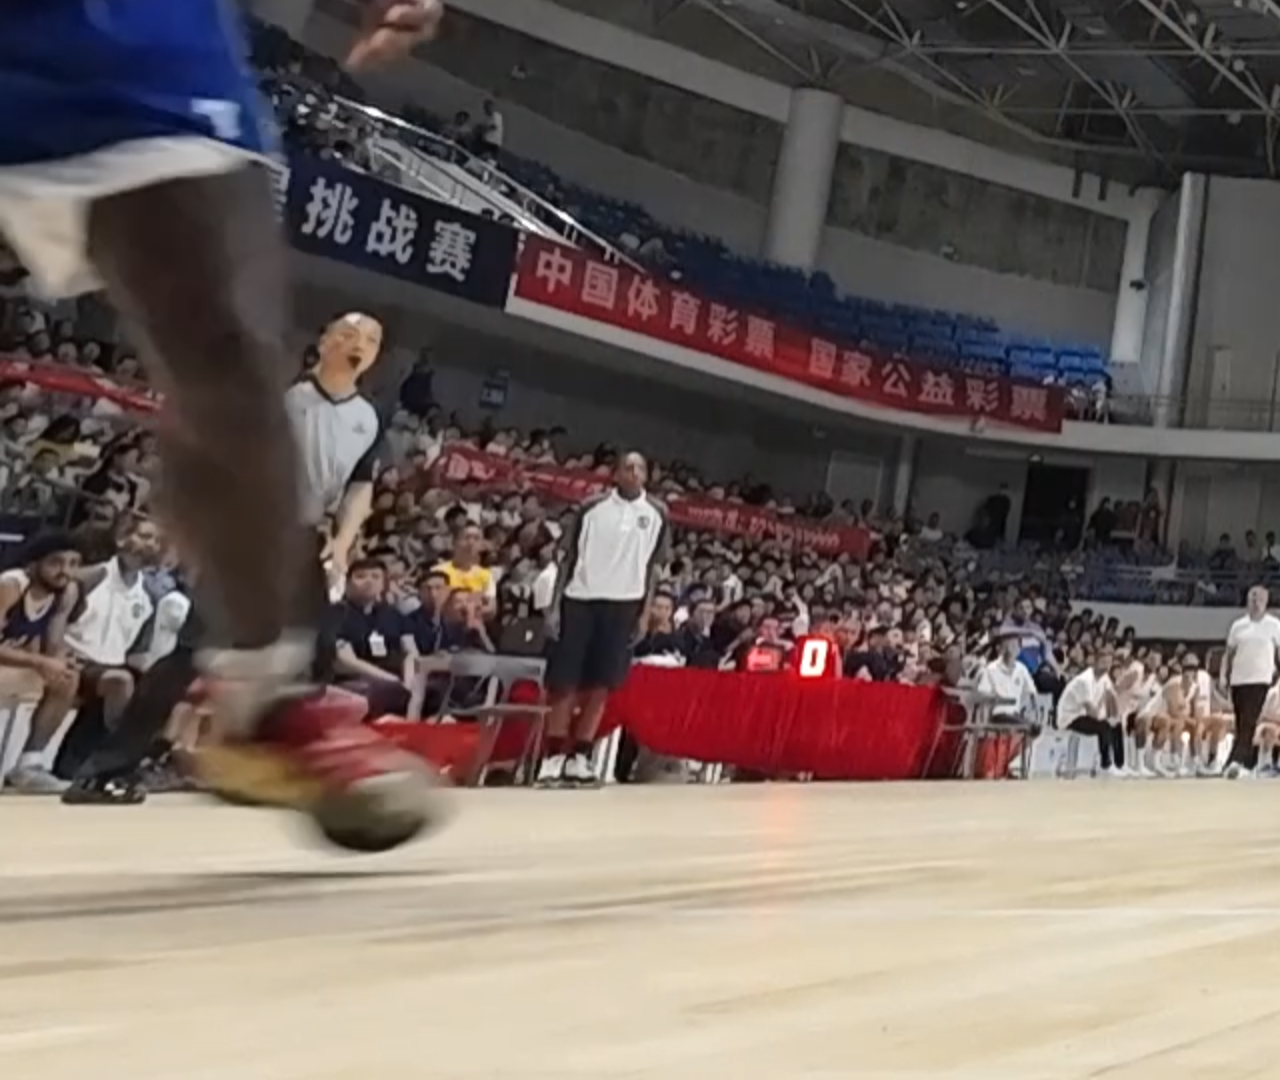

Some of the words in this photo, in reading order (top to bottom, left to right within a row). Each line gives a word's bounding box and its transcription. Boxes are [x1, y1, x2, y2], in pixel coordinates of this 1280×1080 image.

[270, 170, 477, 282] 挑战赛
[536, 247, 777, 360] 中国体育彩票
[808, 337, 1049, 422] 国家公益彩票
[800, 639, 829, 677] 0
